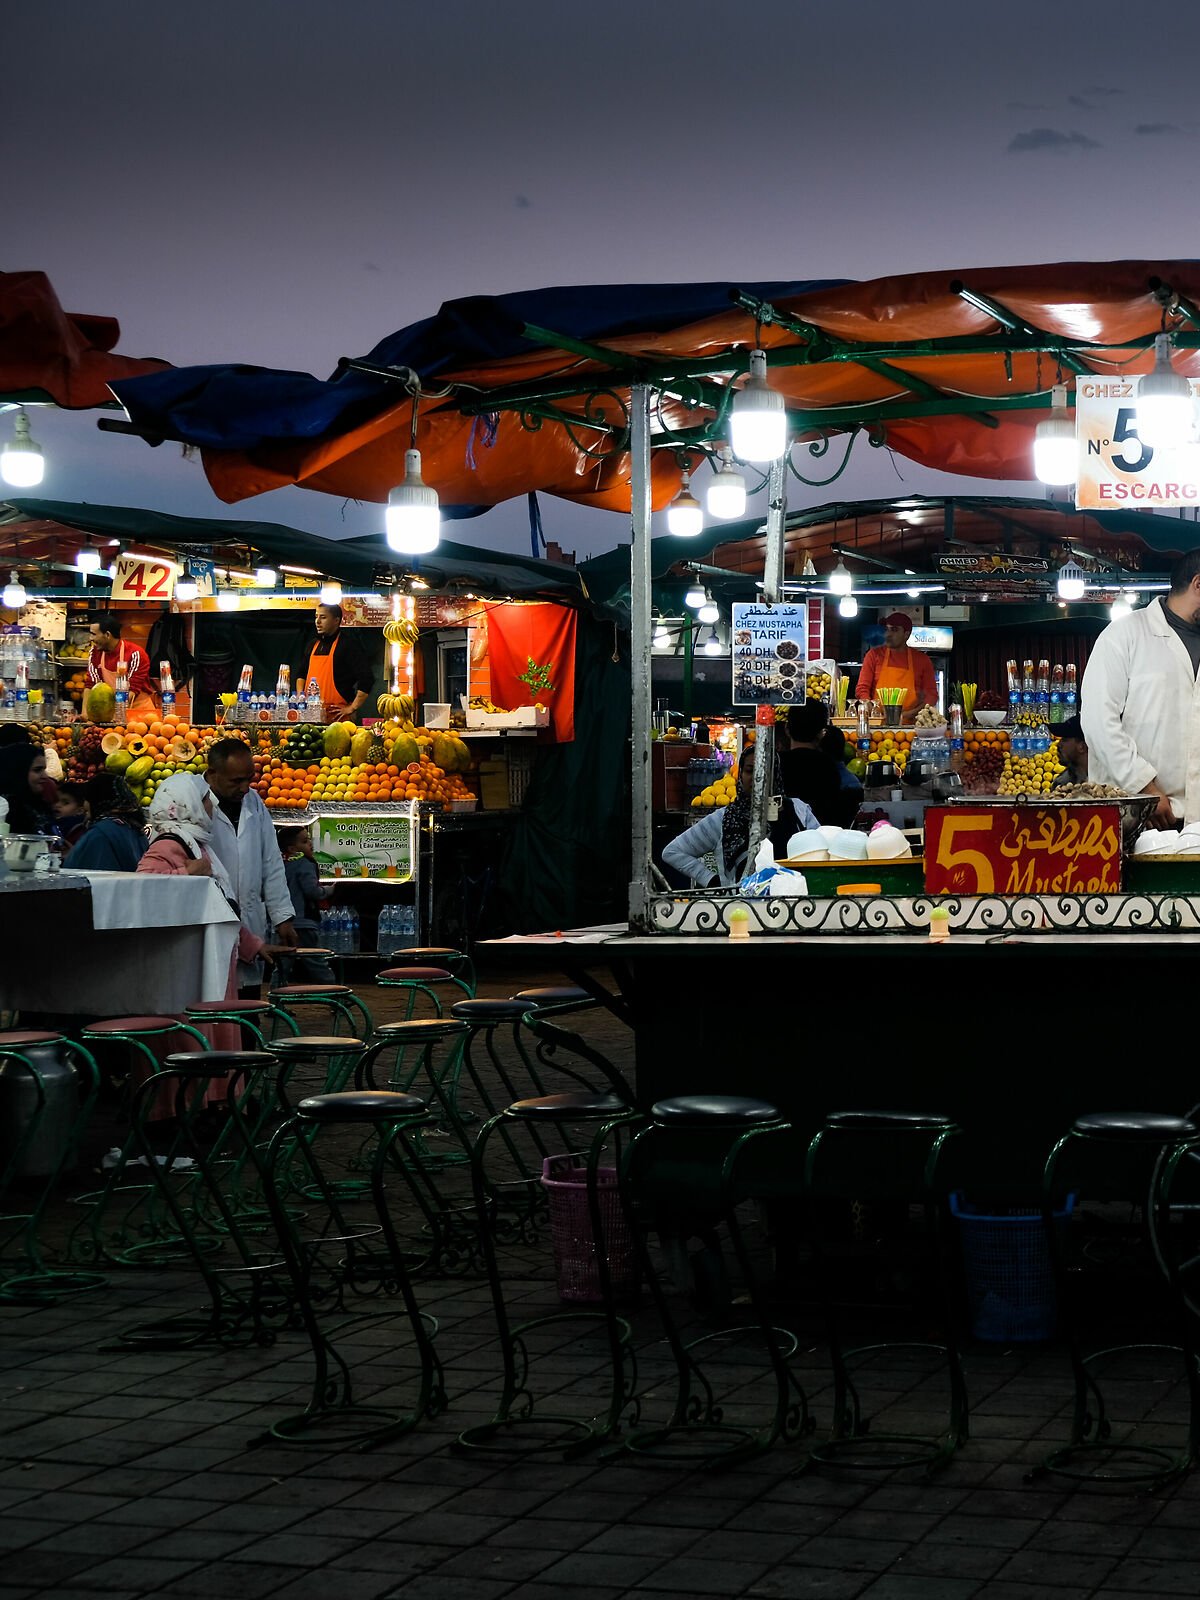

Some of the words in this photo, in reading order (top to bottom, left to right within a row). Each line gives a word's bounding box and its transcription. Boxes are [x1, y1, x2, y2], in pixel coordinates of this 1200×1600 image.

[1081, 383, 1134, 398] CHEZ
[1111, 407, 1154, 473] 5
[939, 557, 979, 566] AHMED
[123, 563, 171, 598] 42
[735, 620, 757, 628] CHEZ
[758, 620, 803, 628] MUSTAPHA
[753, 630, 787, 640] TARIF
[739, 647, 752, 656] 40
[755, 647, 771, 656] DH
[739, 662, 752, 671] 20
[755, 662, 771, 671] DH
[755, 675, 771, 685] DH
[348, 823, 358, 831] dh
[345, 838, 356, 846] dh
[936, 814, 995, 894] 5
